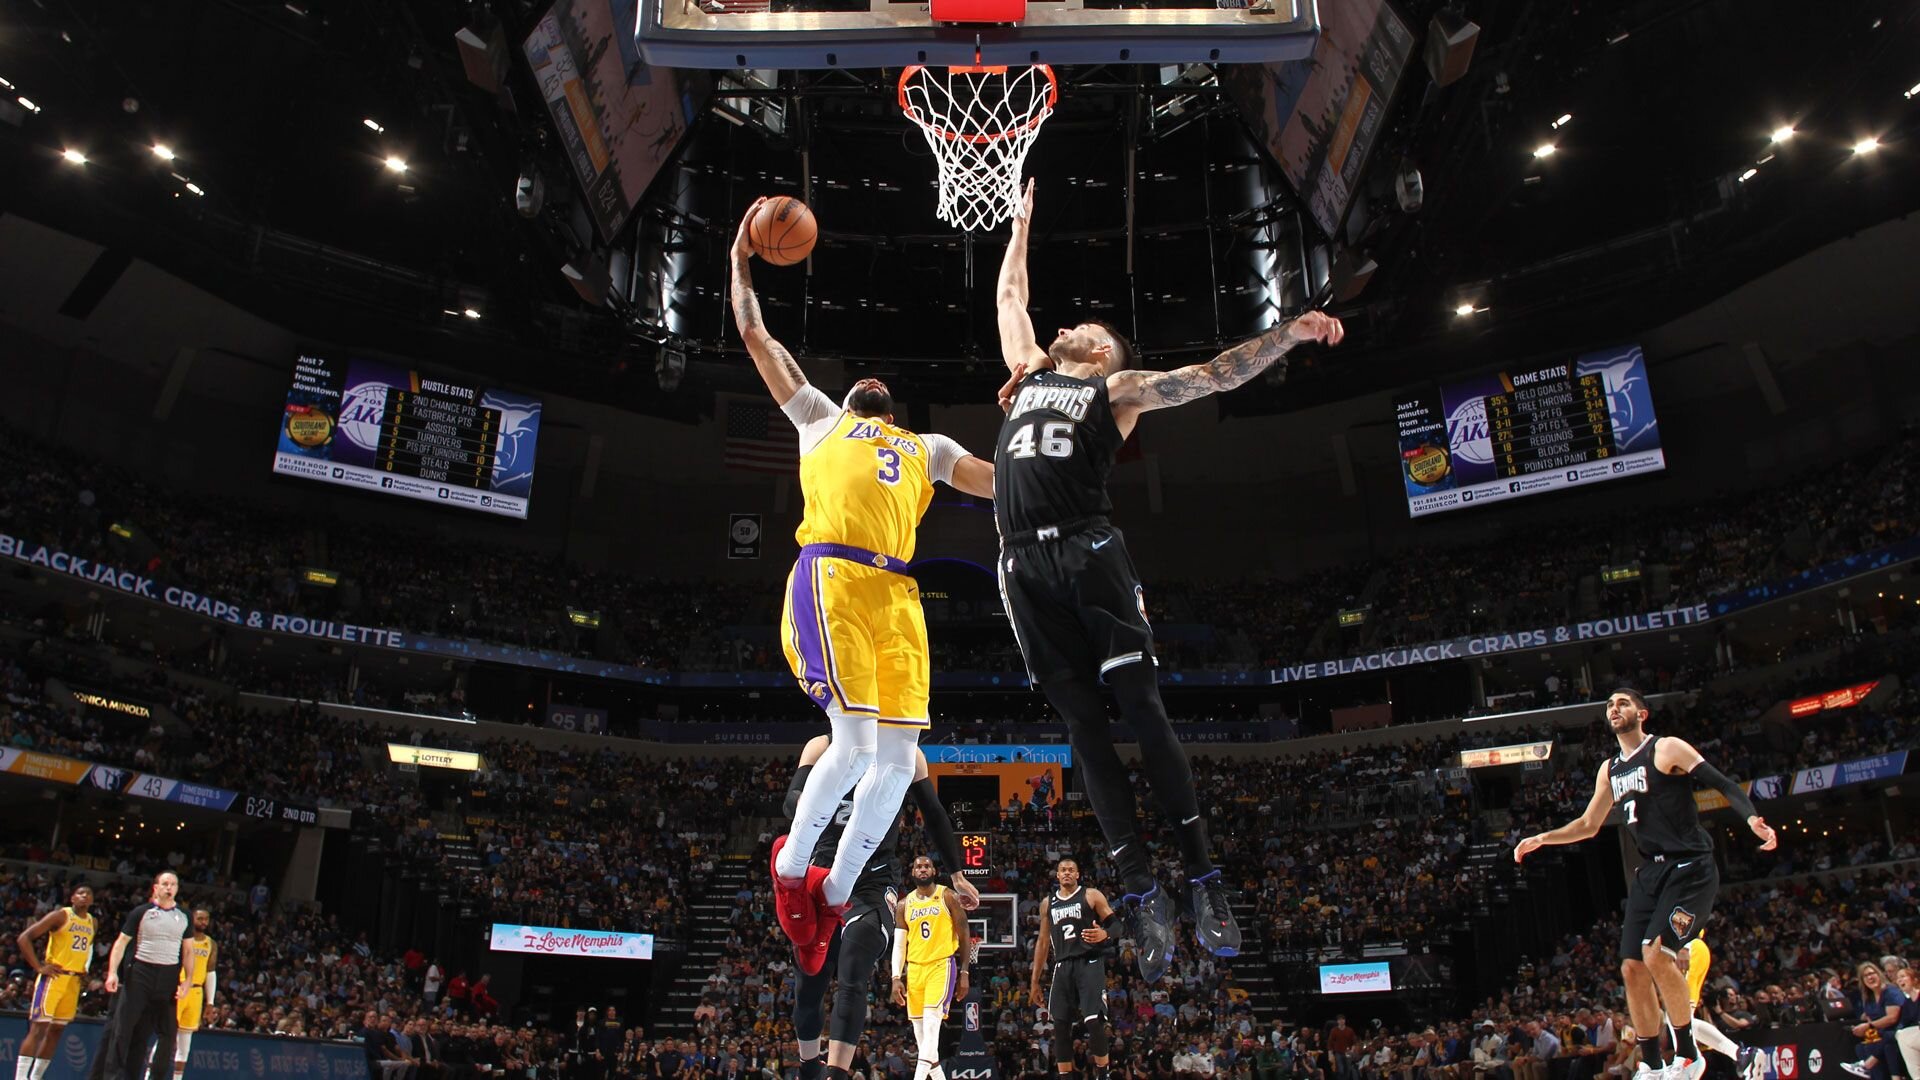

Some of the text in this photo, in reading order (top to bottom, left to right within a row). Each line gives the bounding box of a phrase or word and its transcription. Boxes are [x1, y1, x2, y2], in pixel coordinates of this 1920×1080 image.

[298, 355, 316, 365] Just
[294, 373, 316, 383] from
[296, 364, 331, 377] minutes
[1513, 365, 1567, 387] GAME STATS
[293, 382, 340, 398] downtown.
[421, 379, 474, 400] HUSTLE STATS
[1515, 389, 1536, 401] FIELD
[1537, 382, 1563, 397] GOALS
[363, 397, 382, 406] LOS
[412, 395, 428, 407] 2ND
[431, 398, 460, 415] CHANCE
[462, 406, 476, 417] PTS
[1008, 385, 1097, 422] MEMPHIS
[1397, 402, 1413, 411] Just
[1517, 402, 1537, 413] FREE
[1539, 393, 1573, 409] THROWS
[413, 407, 456, 424] FASTBREAK
[457, 417, 472, 428] PTS
[1398, 408, 1429, 420] minutes
[1466, 414, 1483, 422] LOS
[1496, 398, 1603, 430] 3-11 3-PT FG 3-14
[425, 422, 457, 436] ASSISTS
[1399, 419, 1418, 428] from
[1400, 422, 1444, 437] downtown.
[1529, 422, 1548, 435] 3-PT
[1550, 420, 1560, 431] FG
[417, 432, 462, 449] TURNOVERS
[1006, 421, 1075, 460] 46
[1530, 430, 1574, 447] REBOUNDS
[1593, 424, 1603, 435] 22
[406, 441, 418, 452] PTS
[419, 443, 430, 454] OFF
[432, 447, 468, 462] TURNOVERS
[477, 456, 485, 465] 10
[1538, 443, 1570, 458] BLOCKS
[278, 463, 327, 477] GRIZZLIES.COM
[421, 456, 450, 470] STEALS
[876, 447, 901, 484] 3
[1508, 447, 1608, 477] 14 POINTS IN PAINT 28
[420, 467, 447, 481] DUNKS
[1414, 499, 1459, 512] GRIZZLIES.COM
[740, 526, 751, 536] 50
[165, 586, 241, 624] CRAPS
[247, 611, 263, 628] &
[271, 614, 403, 648] ROULETTE
[1271, 663, 1317, 684] LIVE
[1468, 629, 1548, 656] CRAPS
[1554, 625, 1571, 643] &
[1578, 602, 1710, 640] ROULETTE
[109, 700, 150, 718] MINOLTA
[551, 712, 576, 731] 95
[715, 733, 771, 741] SUPERIOR
[1198, 732, 1228, 741] WORT
[422, 754, 453, 764] LOTTERY
[1805, 769, 1825, 789] 43
[1843, 758, 1881, 773] TIMEOUTS:
[1845, 772, 1870, 783] FOULS:
[143, 777, 163, 798] 43
[182, 783, 216, 797] TIMEOUTS:
[246, 796, 274, 819] 6:24
[282, 807, 298, 820] 2ND
[1623, 799, 1638, 825] 7
[962, 835, 987, 847] 6:24
[965, 847, 985, 866] 12
[910, 906, 940, 921] LAKERS
[1051, 903, 1082, 925] MEMPHIS
[920, 921, 930, 939] 6
[1062, 924, 1076, 940] 2
[72, 935, 88, 951] 28
[524, 935, 536, 948] I
[572, 933, 623, 953] Memphis
[193, 1051, 239, 1070] AT&T 5G
[1808, 1057, 1823, 1068] TNT
